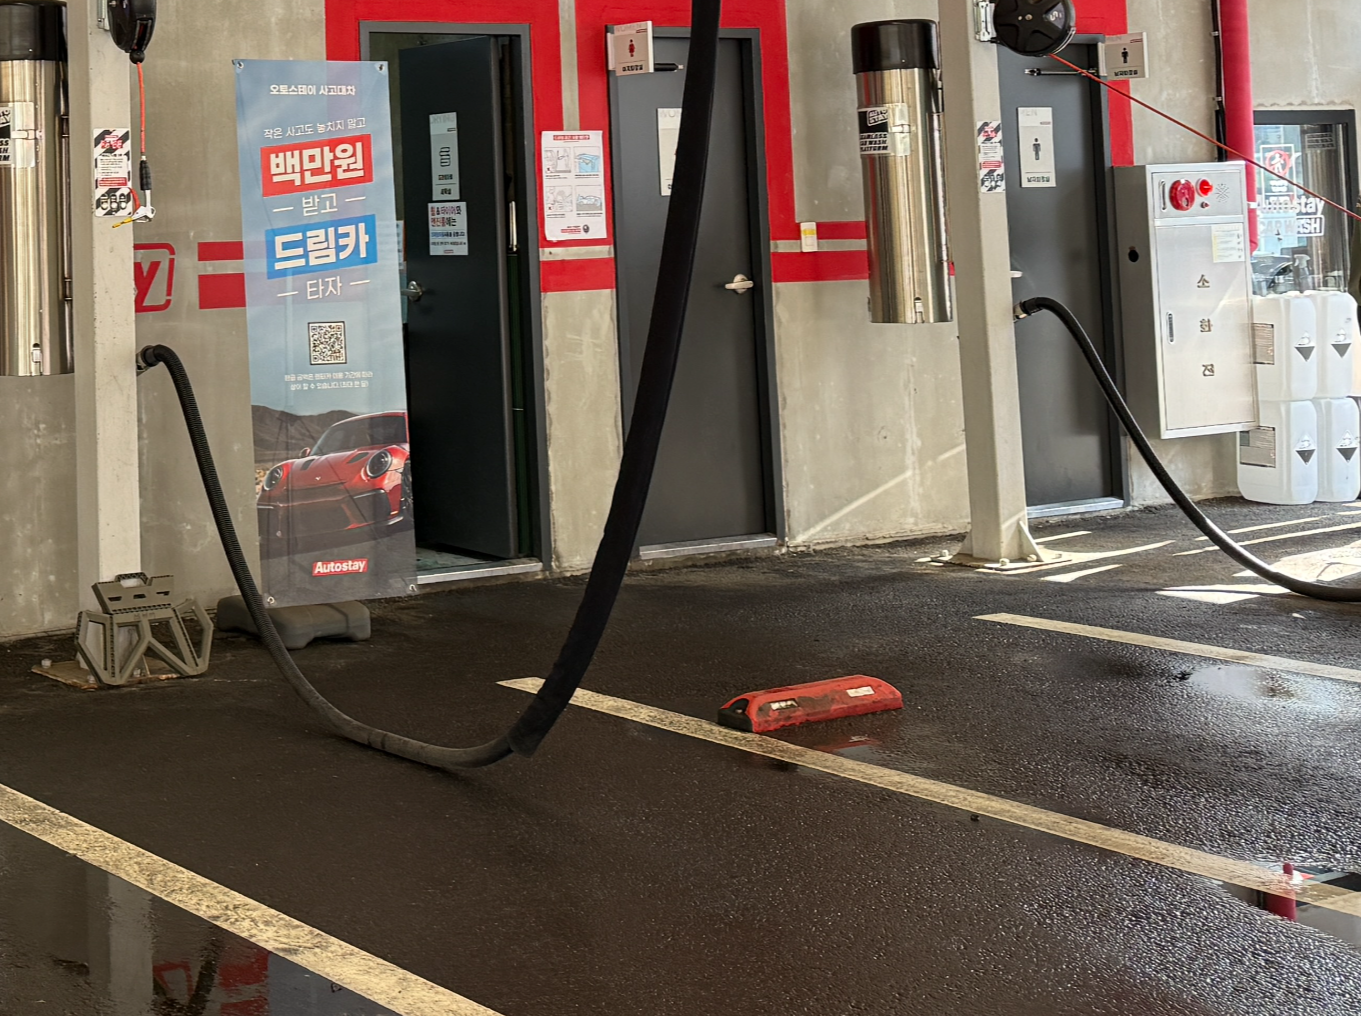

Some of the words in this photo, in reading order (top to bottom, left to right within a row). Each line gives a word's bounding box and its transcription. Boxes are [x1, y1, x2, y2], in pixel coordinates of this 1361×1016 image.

[269, 84, 316, 95] 오토스테이
[319, 84, 356, 96] 사고대차
[263, 127, 283, 139] 작은
[285, 124, 314, 137] 사고도
[316, 119, 345, 133] 놓치지
[347, 117, 367, 129] 않고
[269, 142, 365, 186] 백만원
[302, 193, 338, 217] 받고
[1285, 217, 1321, 235] WASH
[274, 223, 369, 270] 드림카
[306, 276, 342, 300] 타자
[314, 560, 366, 574] Autostay
